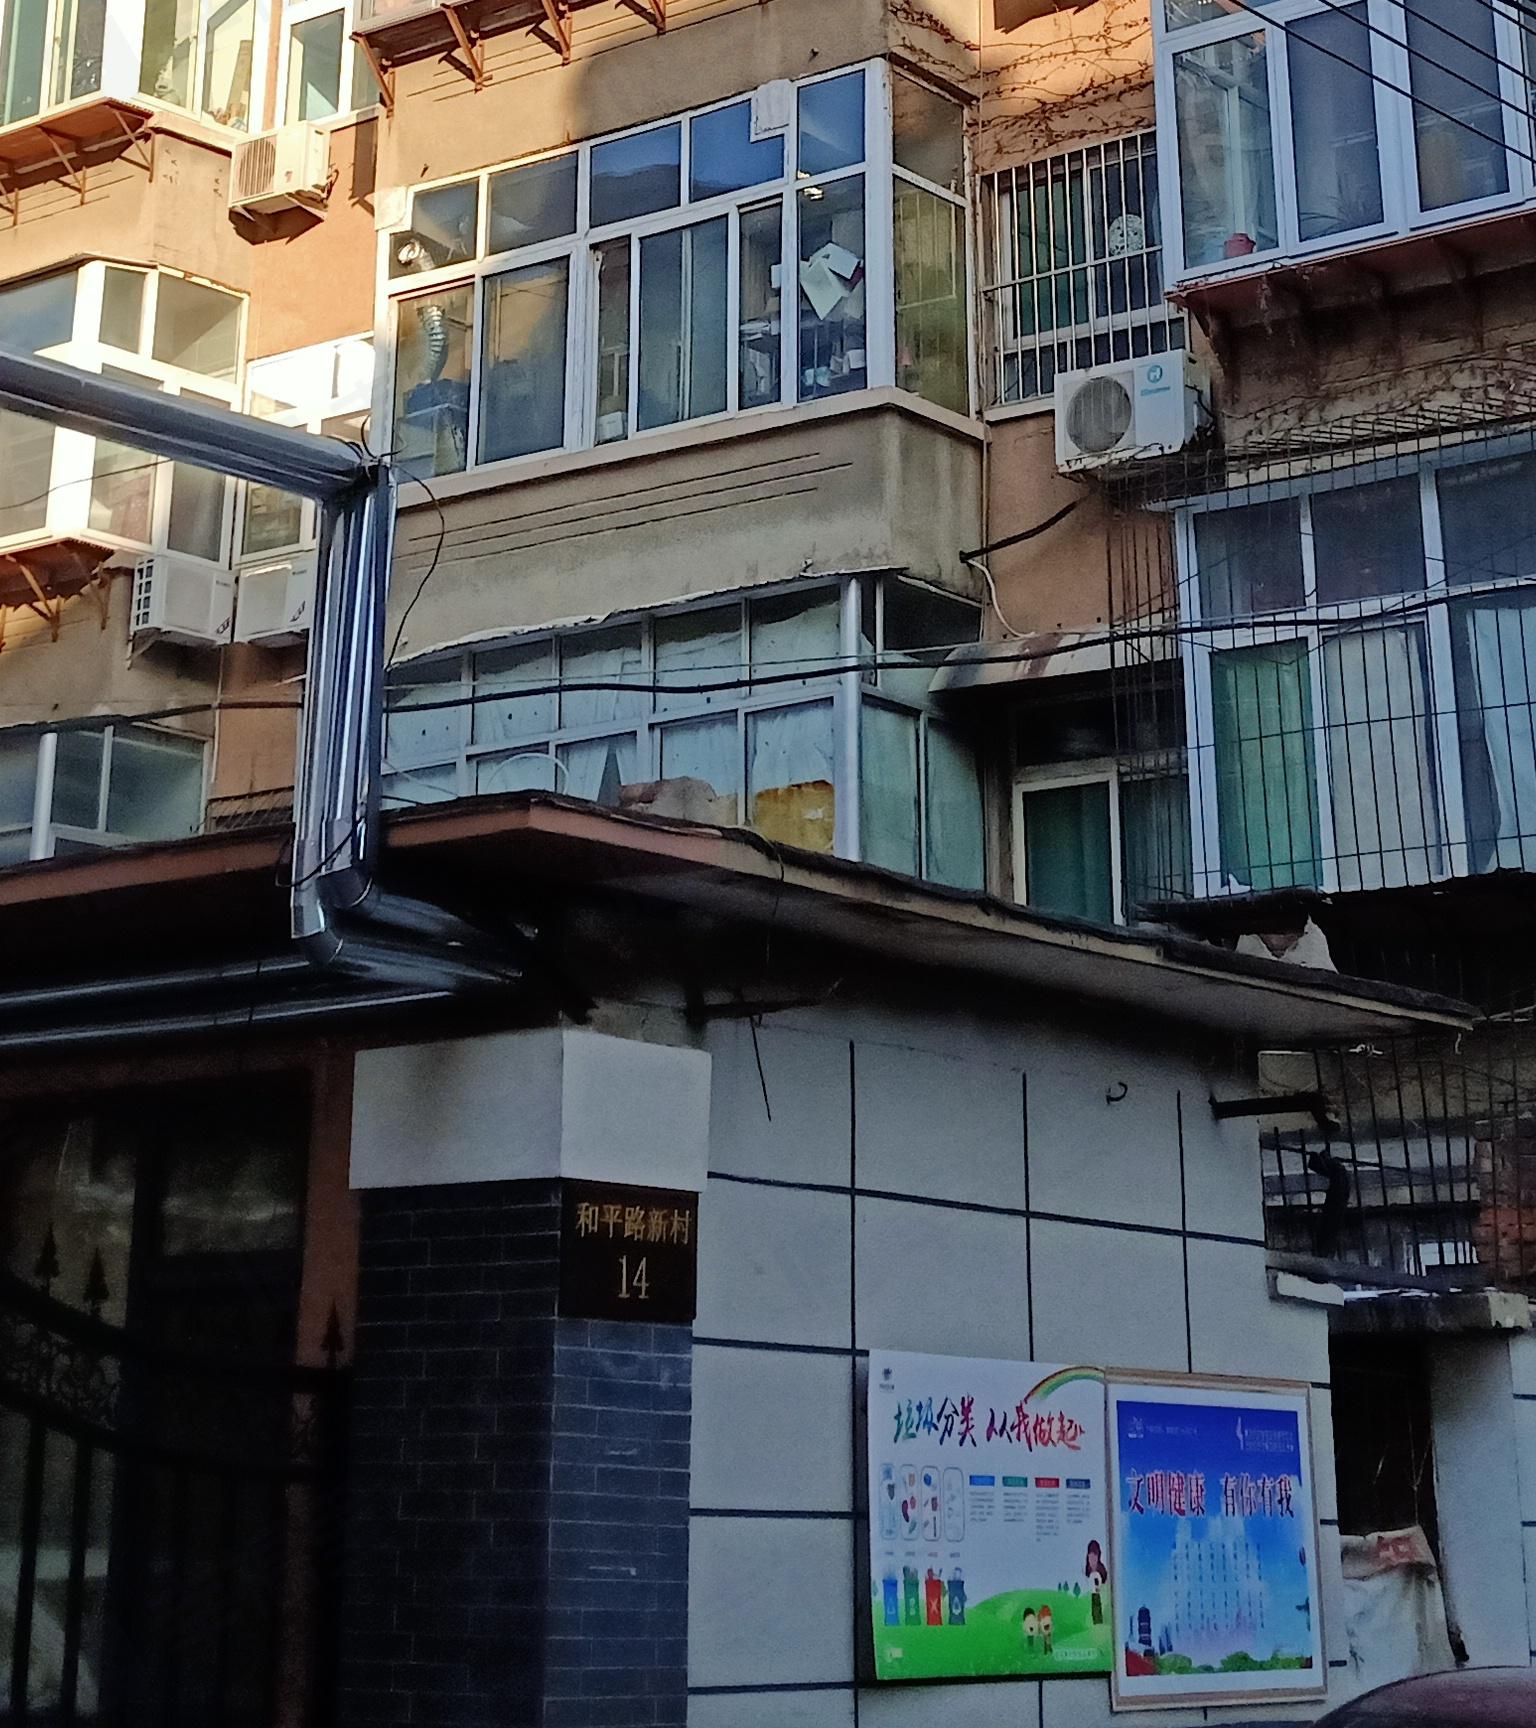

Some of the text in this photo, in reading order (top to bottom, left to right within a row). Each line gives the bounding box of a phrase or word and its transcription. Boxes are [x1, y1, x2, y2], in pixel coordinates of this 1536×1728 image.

[575, 1201, 692, 1245] 和平路新村
[618, 1254, 650, 1300] 14
[893, 1392, 1086, 1453] 垃圾分类 从我做起
[1125, 1466, 1206, 1519] 文明健康
[1220, 1471, 1295, 1519] 有你有我
